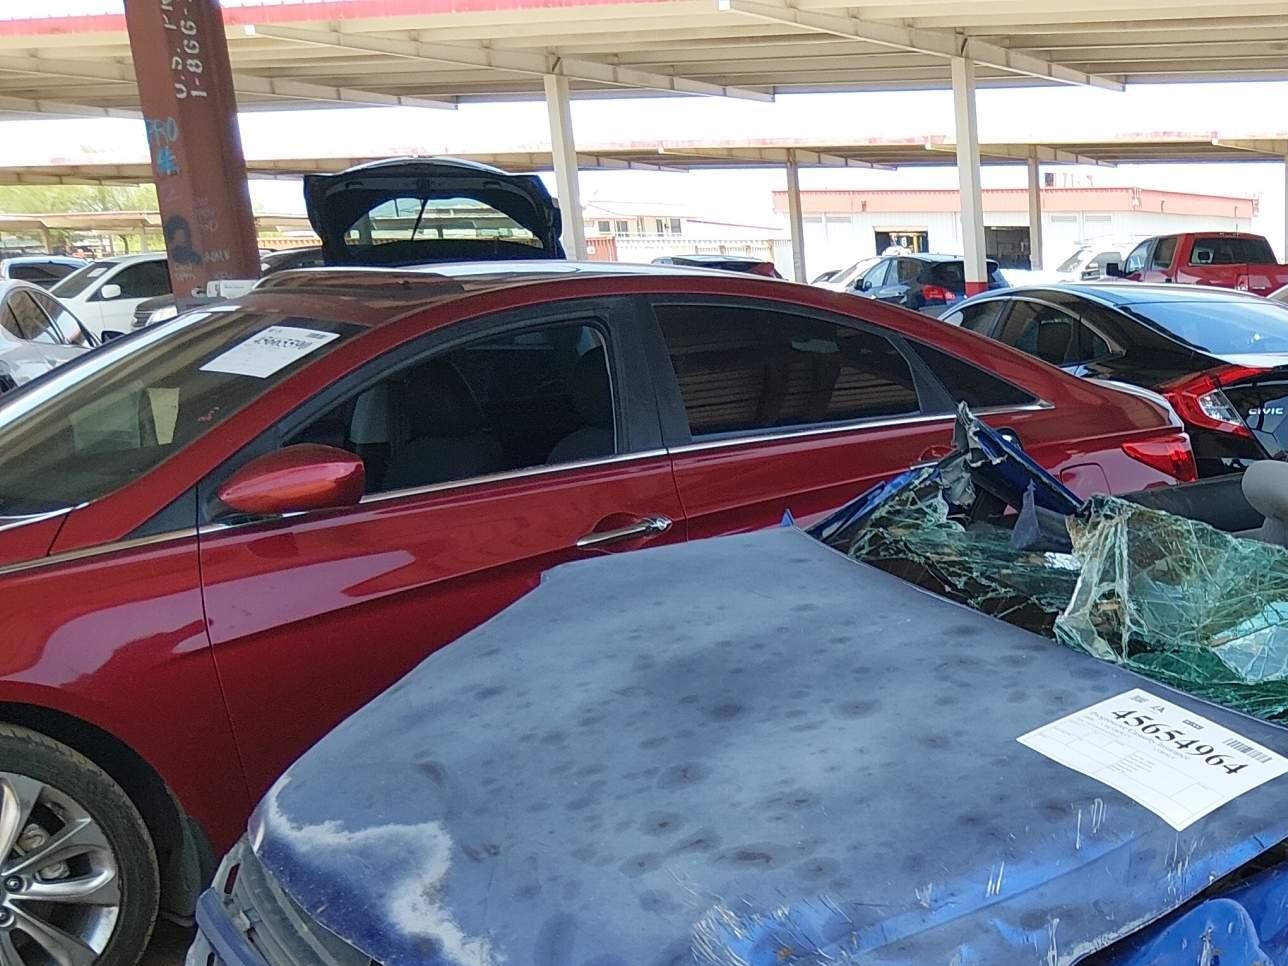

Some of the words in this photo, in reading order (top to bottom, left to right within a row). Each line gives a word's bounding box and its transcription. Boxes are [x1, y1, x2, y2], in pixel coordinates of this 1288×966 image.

[180, 0, 208, 97] 1-866-
[1248, 407, 1284, 415] CIVIC
[1111, 709, 1249, 775] 45654964
